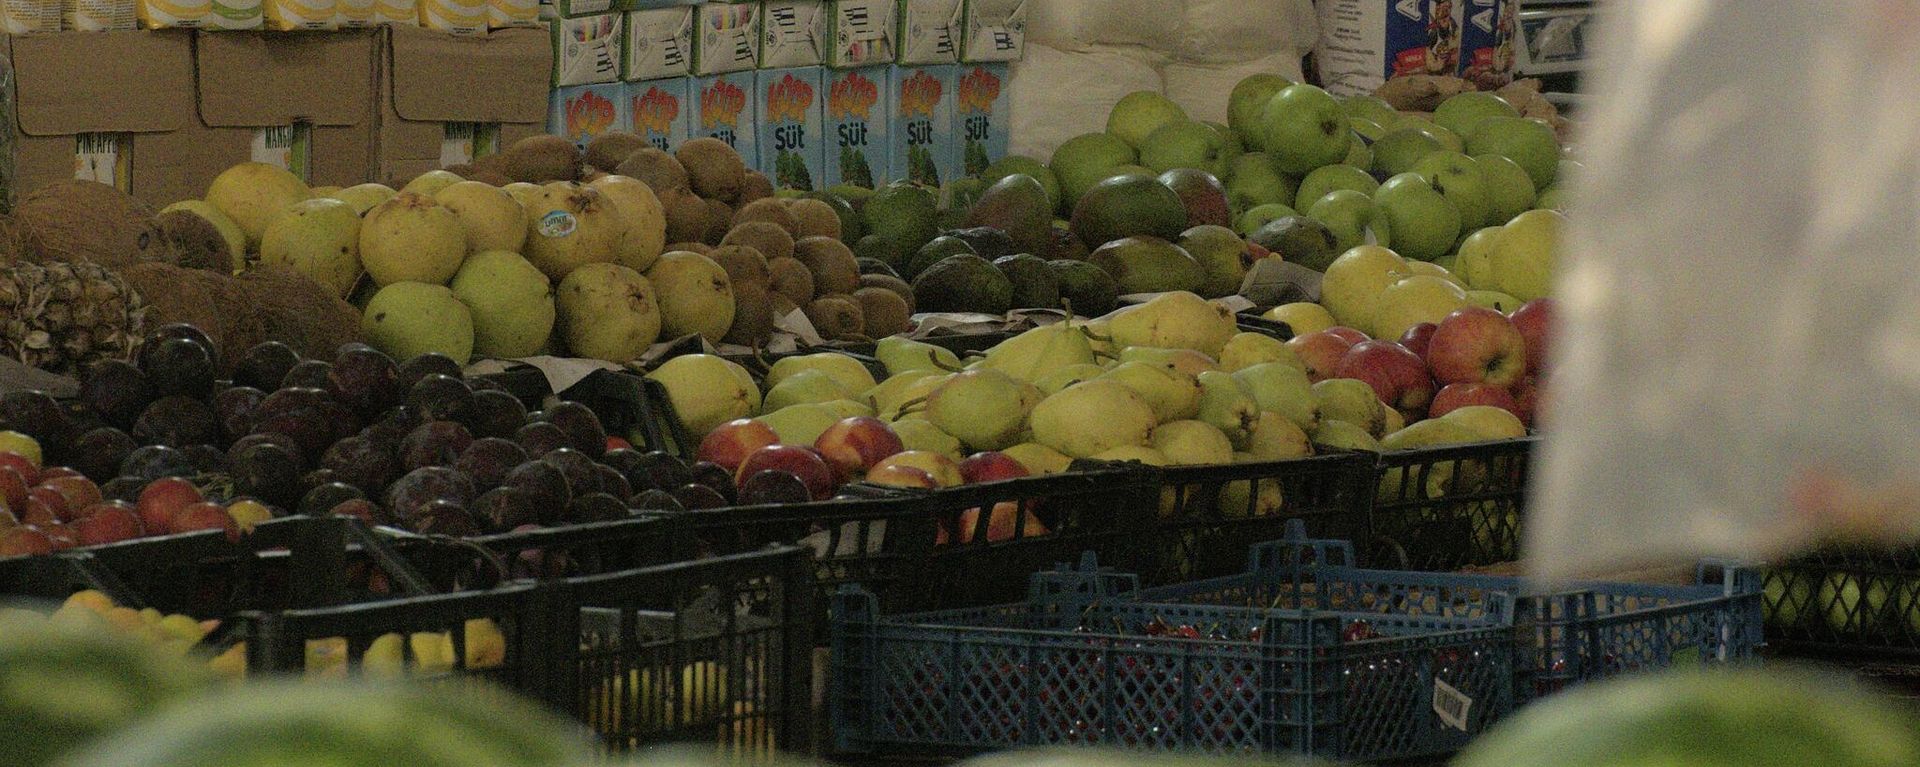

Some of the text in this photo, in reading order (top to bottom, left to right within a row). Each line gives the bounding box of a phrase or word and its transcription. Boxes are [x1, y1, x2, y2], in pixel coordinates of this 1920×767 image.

[774, 124, 804, 150] Süt
[838, 122, 868, 146] Süt
[907, 120, 933, 145] Süt
[965, 116, 990, 141] Süt
